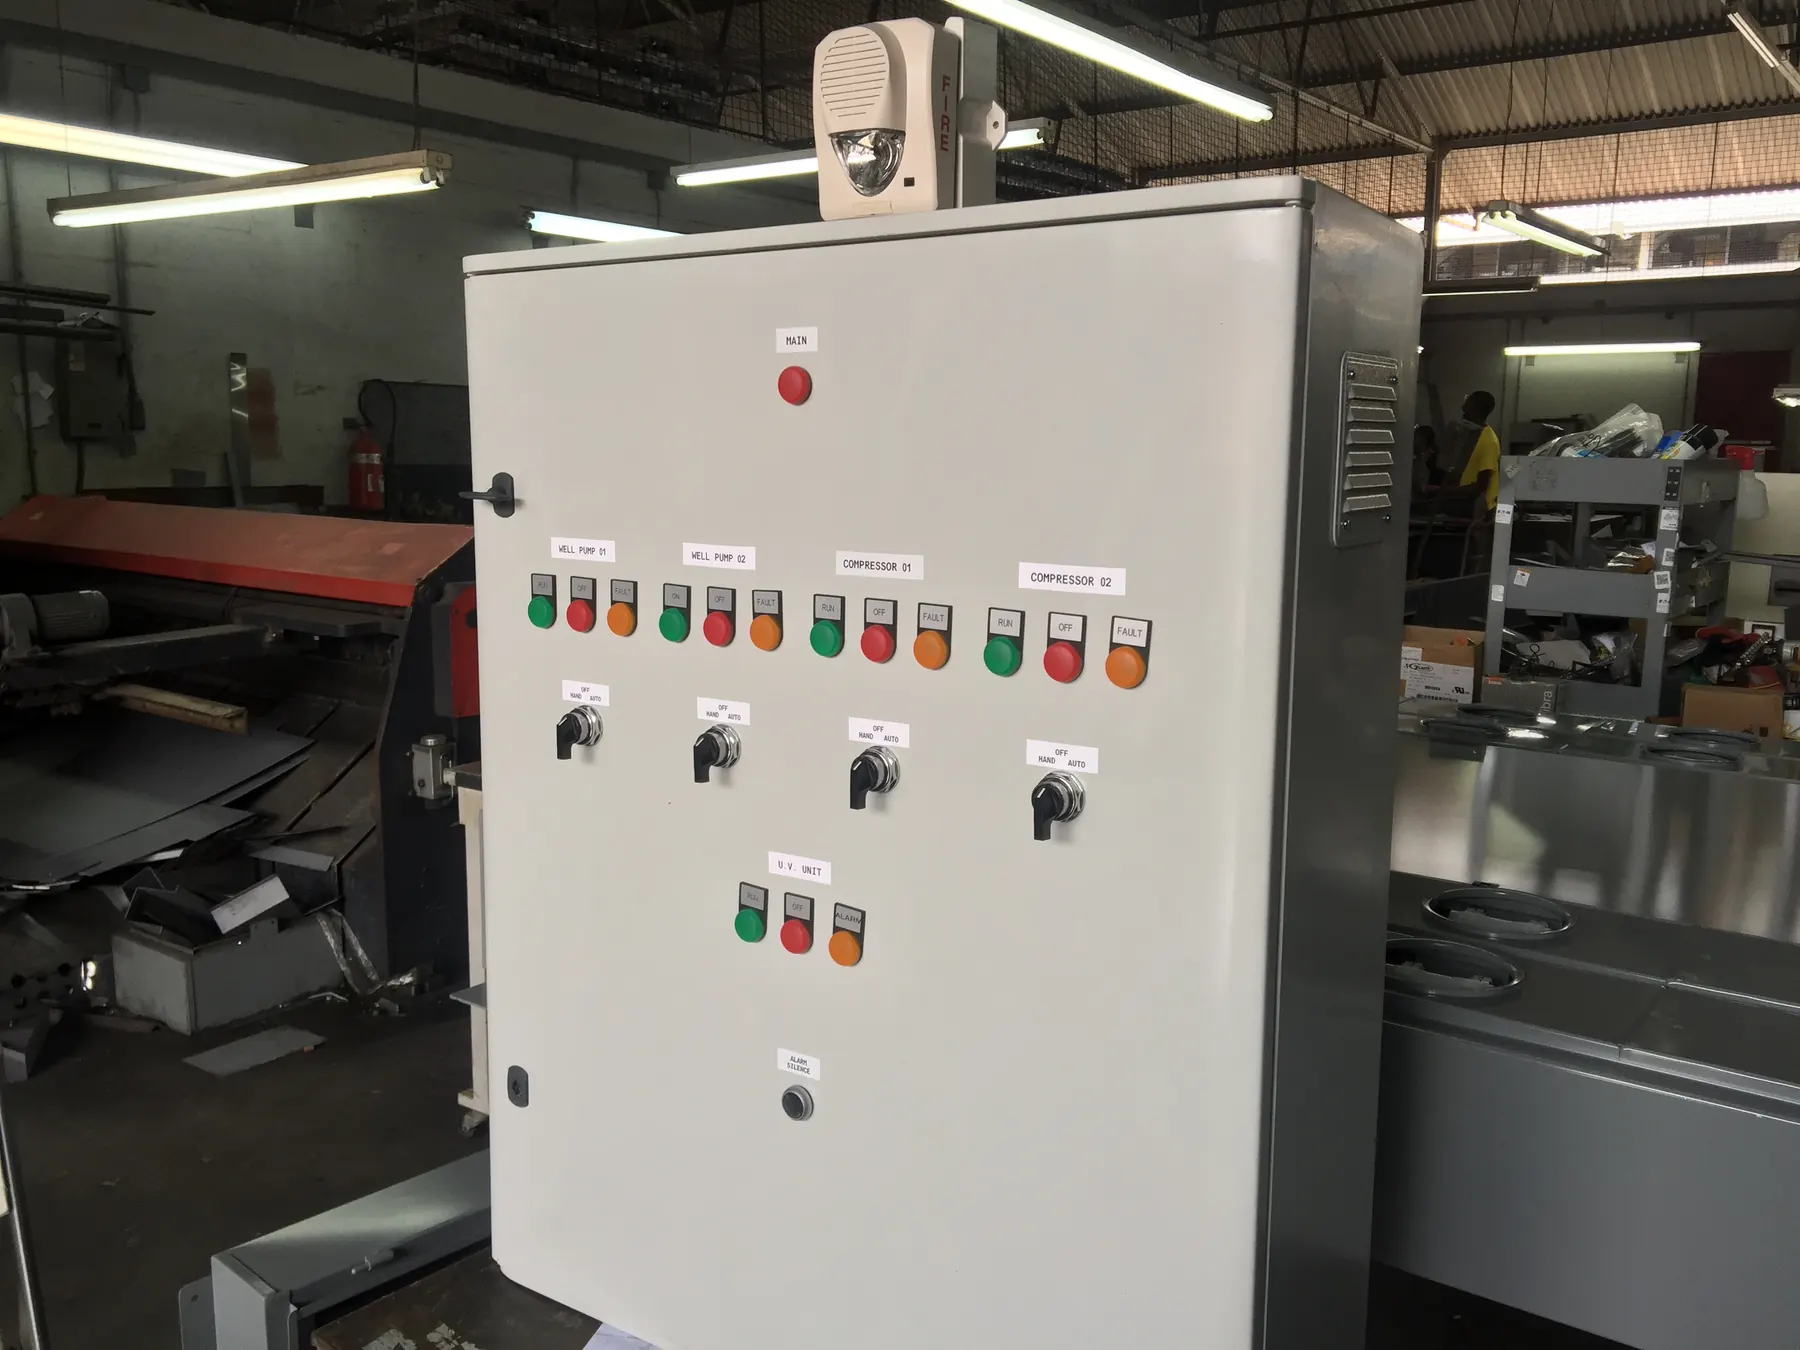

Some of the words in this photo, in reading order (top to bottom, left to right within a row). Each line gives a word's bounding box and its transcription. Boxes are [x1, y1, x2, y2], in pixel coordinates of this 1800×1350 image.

[941, 74, 951, 152] FIRE
[785, 335, 807, 346] MAIN
[558, 544, 576, 555] WELL
[578, 546, 596, 556] PUMP
[599, 547, 607, 557] 01
[691, 551, 710, 562] WELL
[714, 552, 733, 563] PUMP
[737, 554, 746, 564] 02
[843, 559, 898, 572] COMPRESSOR
[902, 562, 912, 573] 01
[1030, 572, 1095, 587] COMPRESSOR
[1100, 576, 1112, 588] 02
[576, 584, 588, 592] OFF
[614, 587, 632, 597] FAULT
[671, 591, 681, 600] ON
[714, 594, 726, 604] OFF
[756, 598, 776, 607] FAULT
[821, 603, 836, 613] RUN
[872, 607, 886, 617] OFF
[922, 612, 944, 623] FAULT
[997, 618, 1014, 628] RUN
[1058, 622, 1073, 633] OFF
[1116, 626, 1144, 638] FAULT
[570, 692, 582, 700] HAND
[589, 695, 602, 703] AUTO
[718, 704, 729, 712] OFF
[706, 711, 720, 719] HAND
[727, 713, 742, 722] AUTO
[872, 725, 885, 733] OFF
[858, 731, 874, 740] HAND
[883, 735, 899, 744] AUTO
[1054, 748, 1069, 757] OFF
[1038, 755, 1056, 765] HAND
[1067, 759, 1086, 769] AUTO
[778, 860, 797, 872] U.V.
[802, 865, 822, 876] UNIT
[746, 892, 759, 902] RUN
[791, 902, 804, 912] OFF
[835, 911, 863, 925] ALARM
[790, 1055, 808, 1066] ALARM
[786, 1062, 811, 1075] SILENCE
